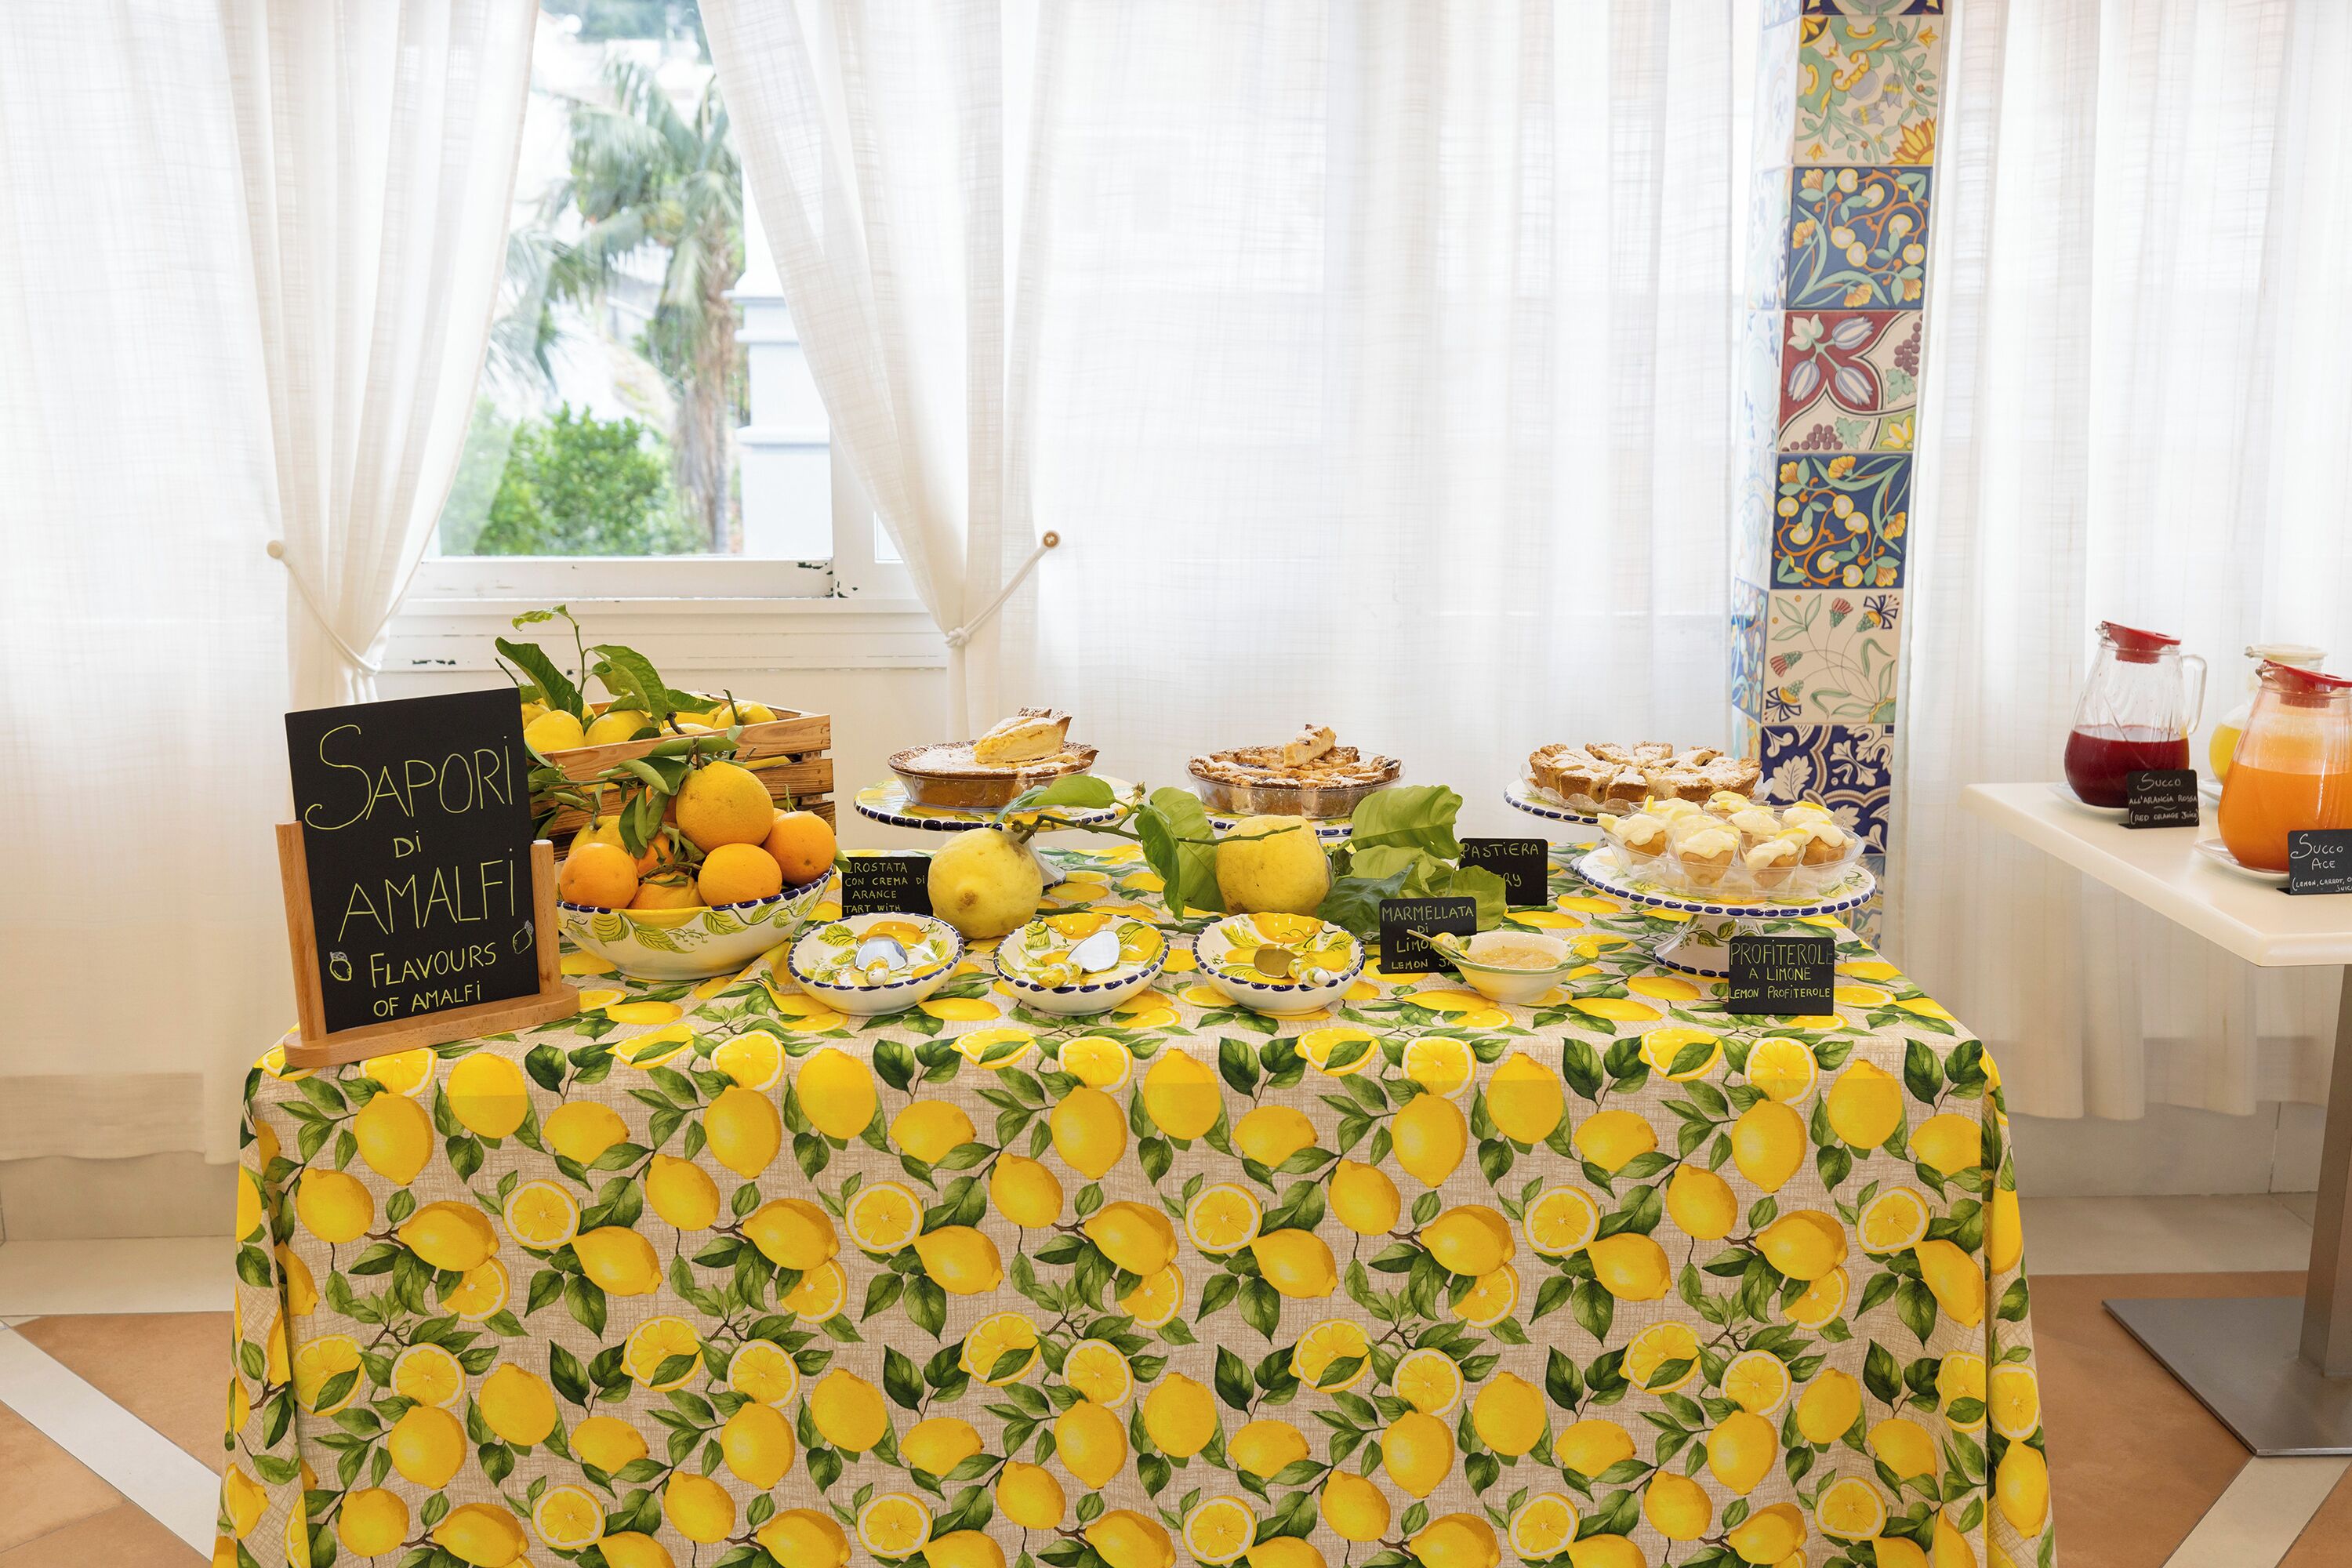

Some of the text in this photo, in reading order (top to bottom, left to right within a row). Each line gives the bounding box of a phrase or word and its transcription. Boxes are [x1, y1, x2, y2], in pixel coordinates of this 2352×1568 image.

[848, 862, 908, 873] ROSTATA
[845, 878, 865, 887] CON
[872, 877, 908, 886] CREMA
[852, 891, 897, 899] ARANCE
[844, 905, 871, 913] TART
[1381, 906, 1475, 922] MARMELLATA
[1396, 937, 1432, 953] LIMO
[370, 942, 496, 988] FLAVOURS
[1391, 958, 1455, 970] LEMON JA
[1749, 967, 1759, 979] A
[1729, 987, 1759, 1000] LEMON
[373, 996, 399, 1017] OF
